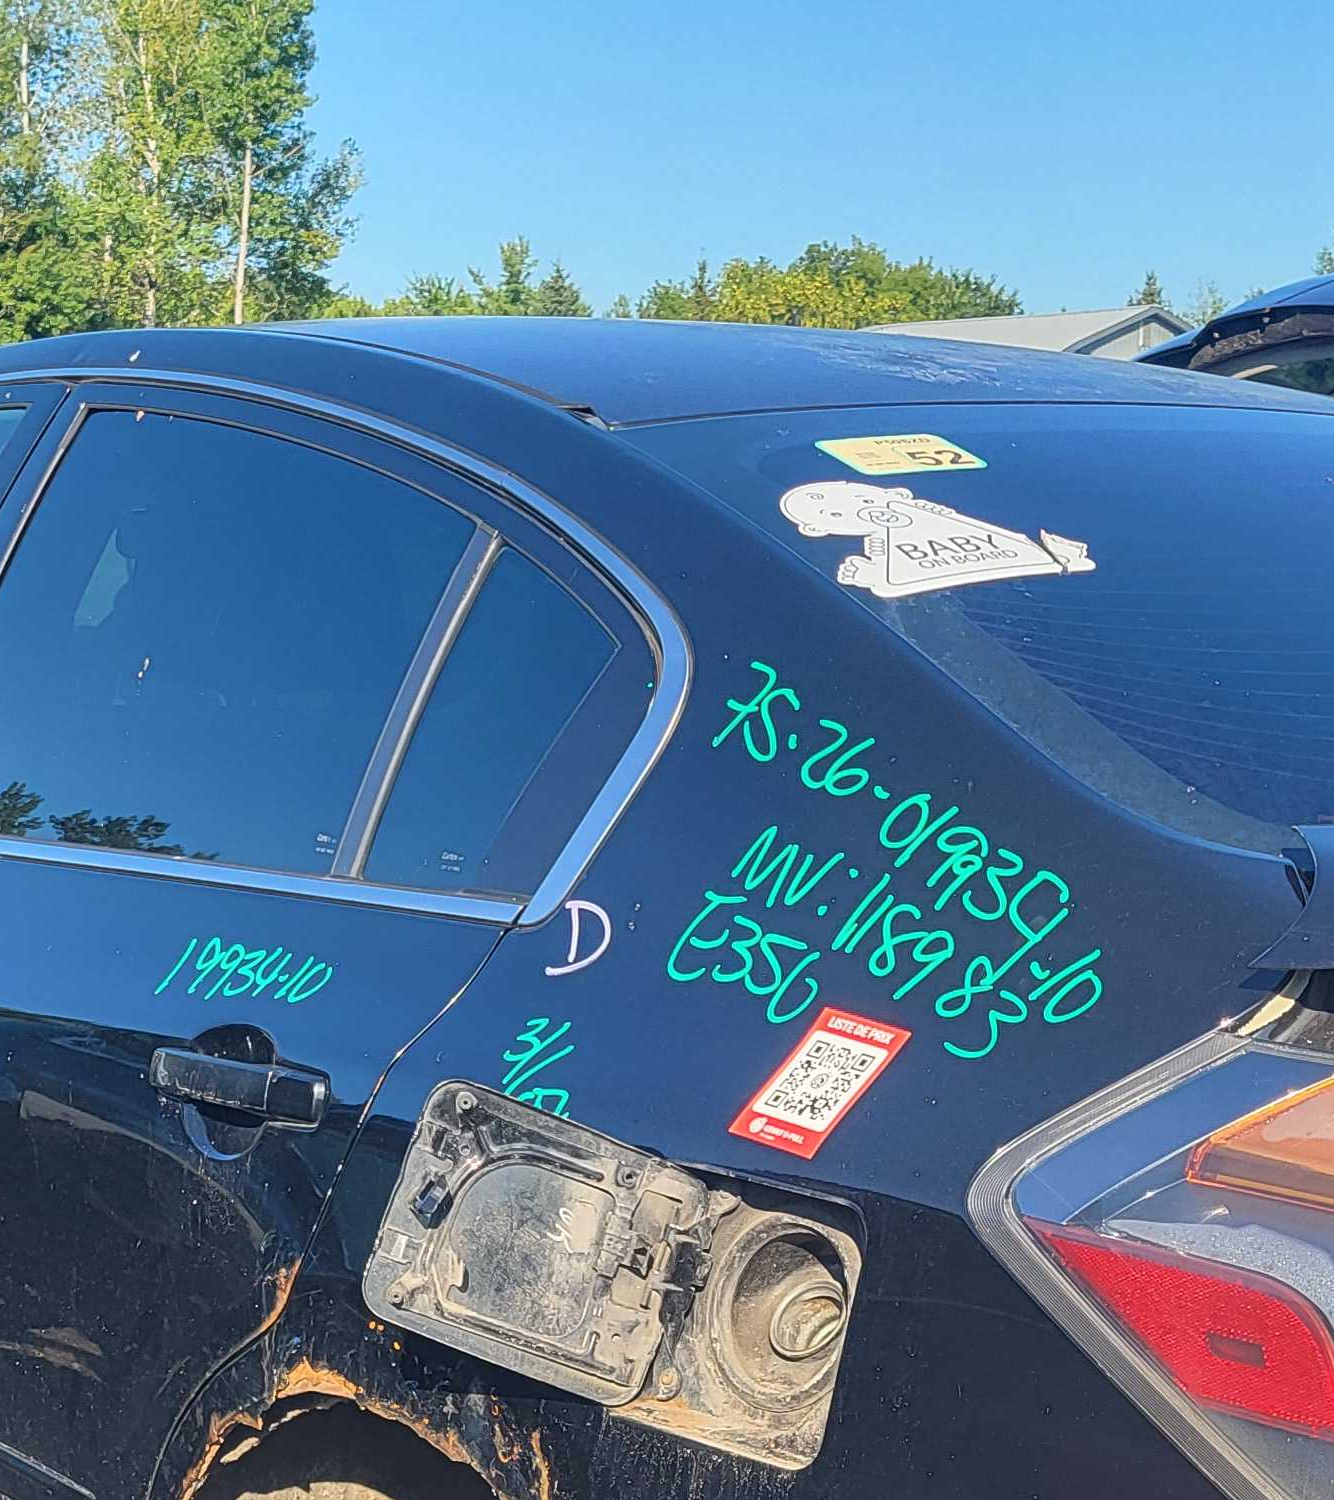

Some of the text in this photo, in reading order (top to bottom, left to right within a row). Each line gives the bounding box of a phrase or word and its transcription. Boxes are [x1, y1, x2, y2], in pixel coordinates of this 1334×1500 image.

[906, 449, 977, 467] 52
[894, 533, 1000, 561] BABY
[918, 549, 1019, 570] ON BOARD
[544, 899, 612, 977] D
[153, 937, 334, 1003] 19934-10
